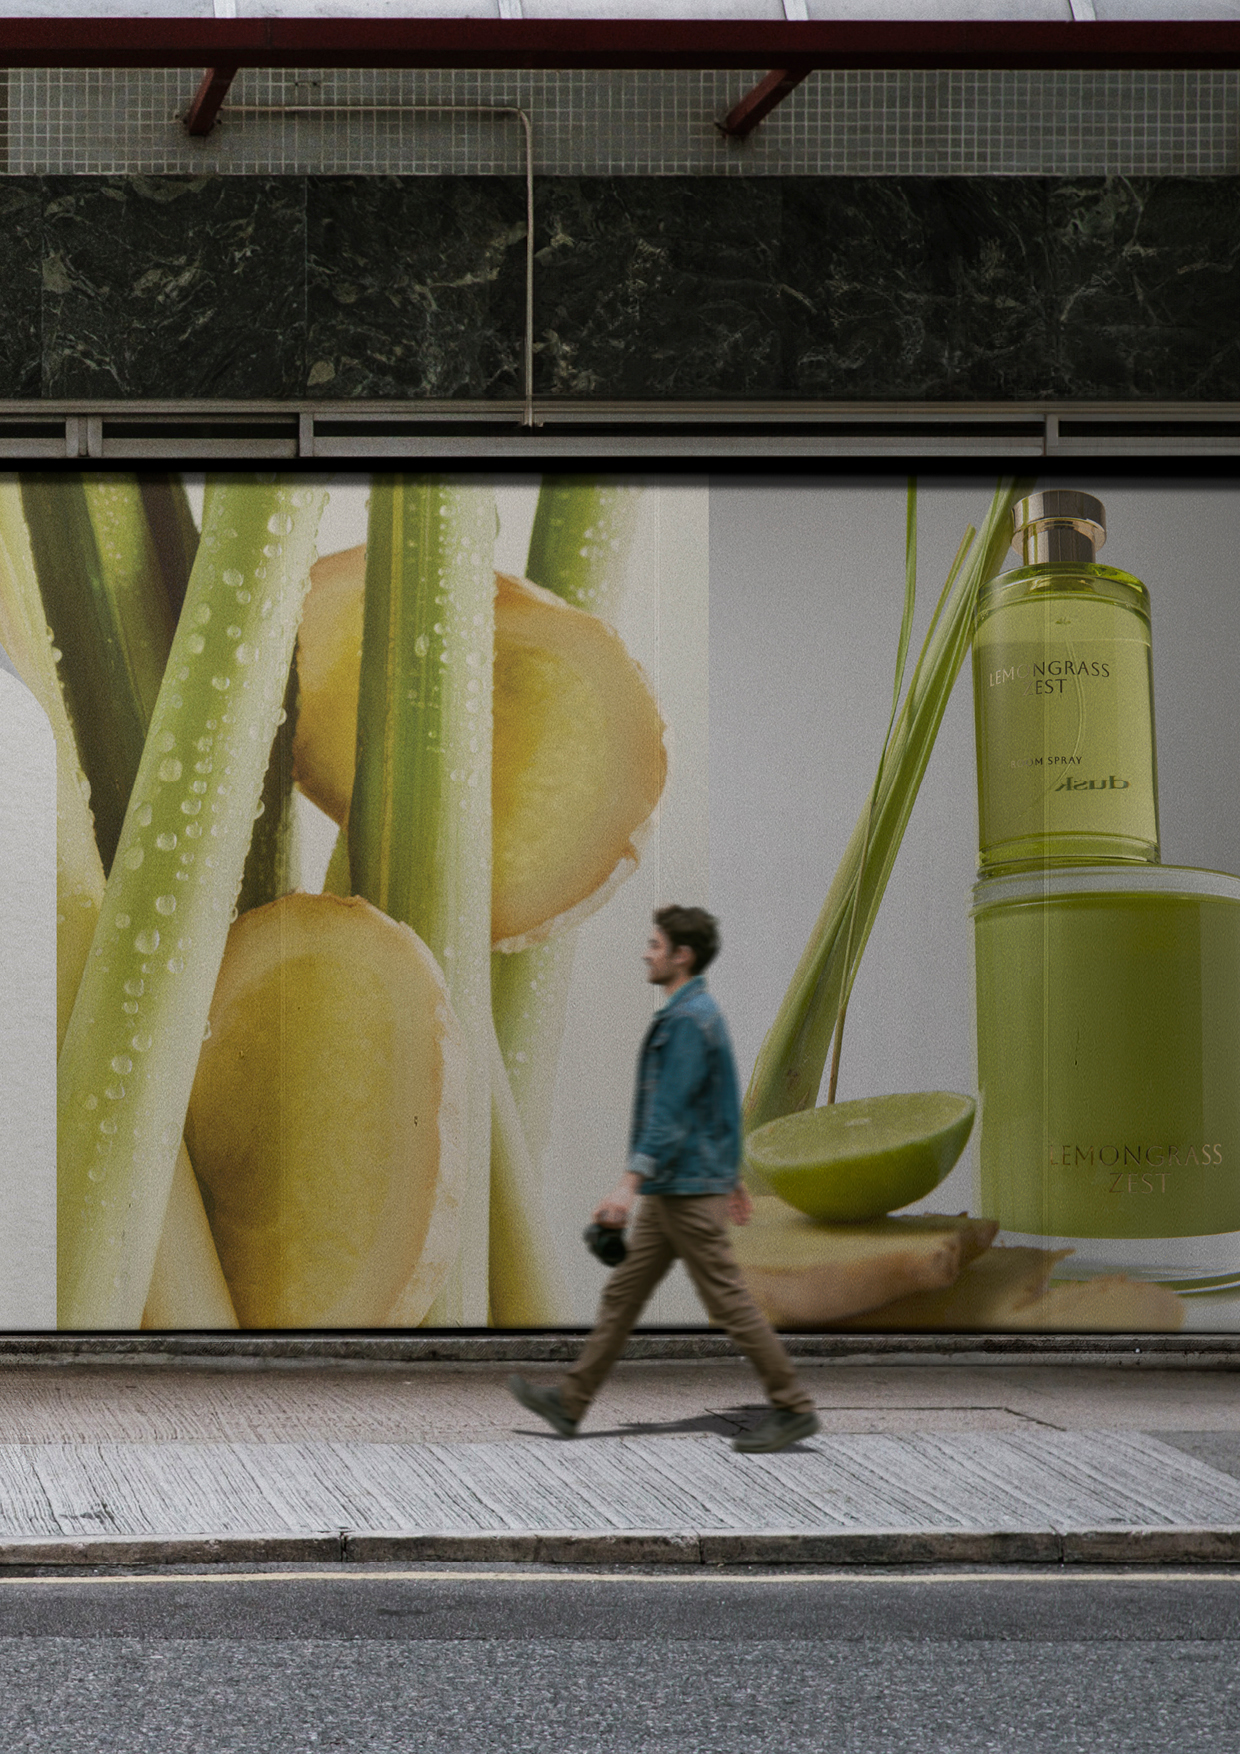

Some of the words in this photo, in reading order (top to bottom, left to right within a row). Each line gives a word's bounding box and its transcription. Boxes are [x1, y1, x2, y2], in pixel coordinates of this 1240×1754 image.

[988, 660, 1111, 688] LEMONGRASS
[1023, 678, 1068, 697] ZEST
[1047, 756, 1083, 766] SPRAY
[1049, 1143, 1224, 1167] LEMONGRASS
[1109, 1172, 1172, 1194] ZEST
